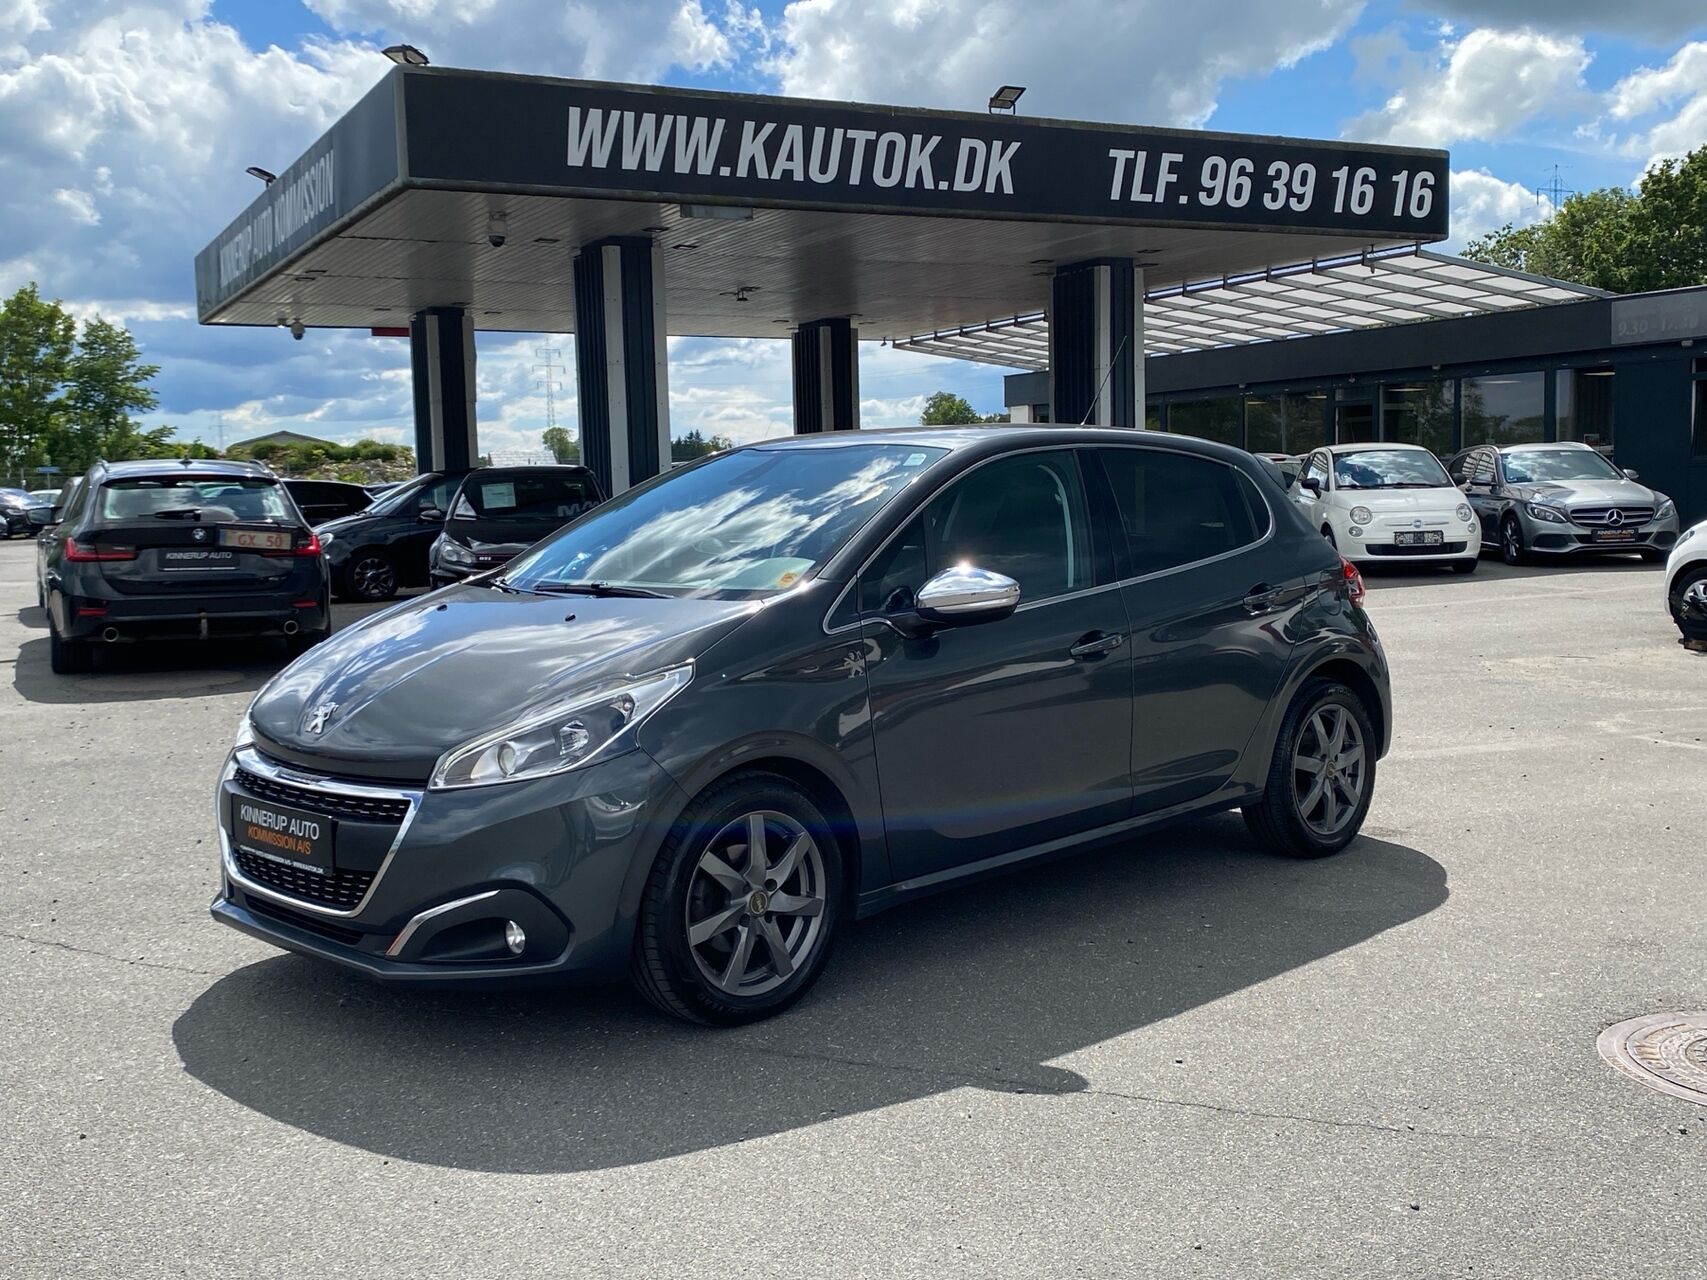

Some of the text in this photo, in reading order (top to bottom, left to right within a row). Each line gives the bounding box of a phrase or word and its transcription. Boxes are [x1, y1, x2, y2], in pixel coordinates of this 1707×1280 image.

[567, 106, 1023, 195] WWW.KAUTOK.DK
[1108, 148, 1435, 219] TLF. 96 39 16 16
[238, 534, 283, 547] GX 50
[166, 552, 209, 560] KINNERUP
[240, 804, 319, 840] KINNERUP AUTO
[248, 825, 296, 850] KOMMISSION
